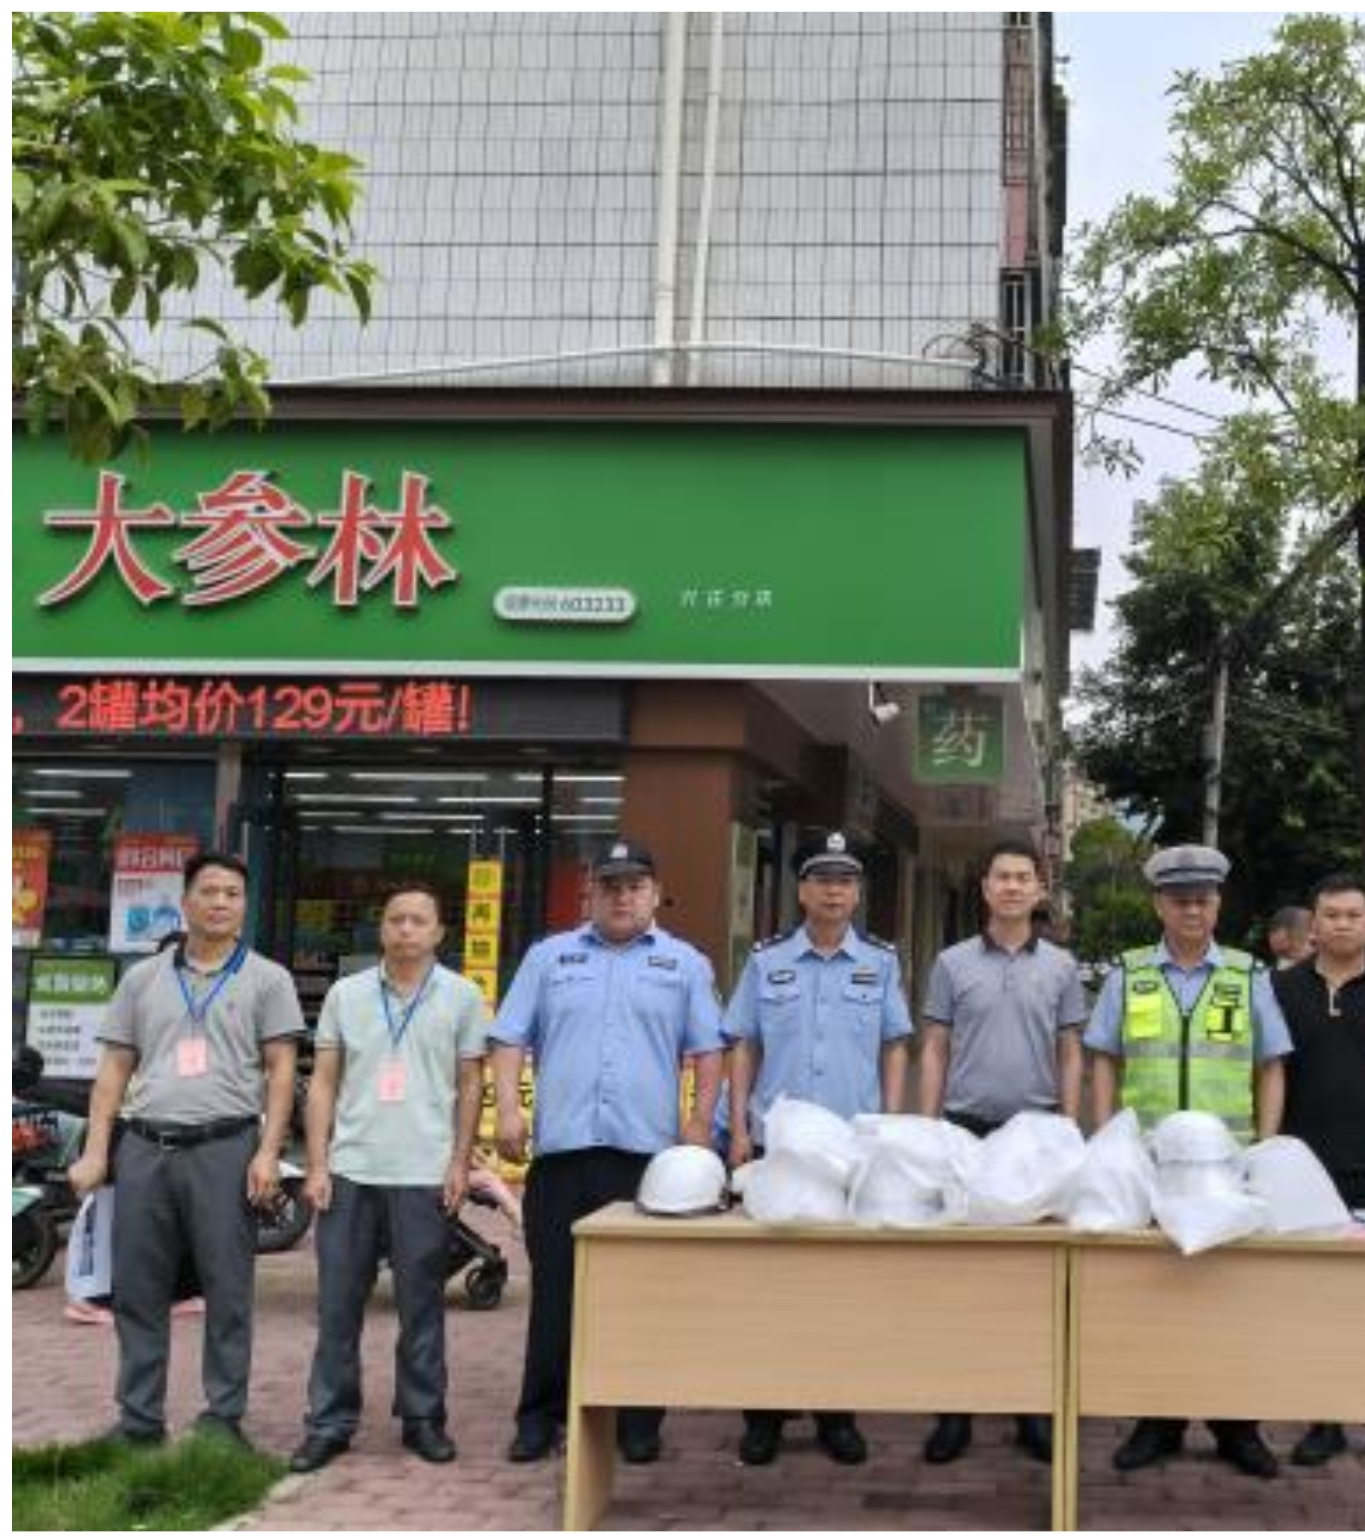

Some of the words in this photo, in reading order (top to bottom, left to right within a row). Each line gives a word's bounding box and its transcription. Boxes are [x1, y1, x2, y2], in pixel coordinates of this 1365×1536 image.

[38, 469, 458, 606] 大参林
[931, 708, 987, 768] 药
